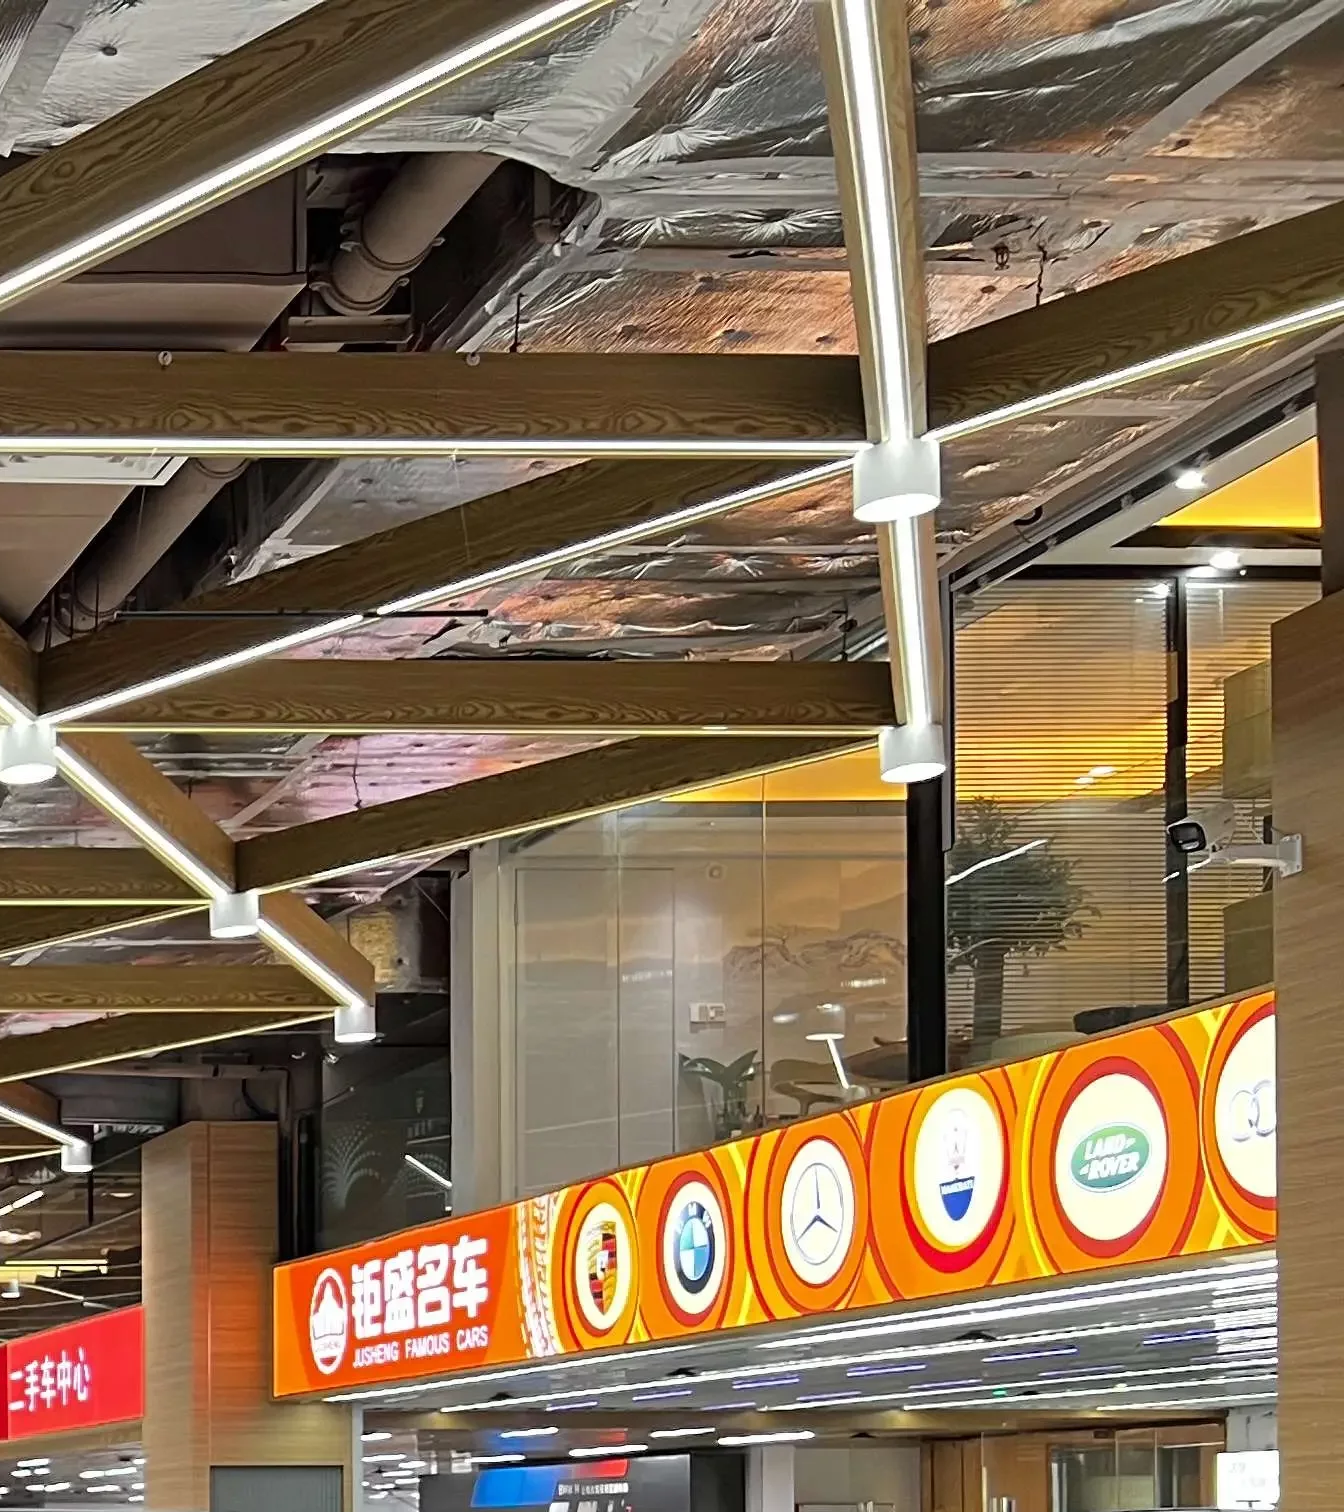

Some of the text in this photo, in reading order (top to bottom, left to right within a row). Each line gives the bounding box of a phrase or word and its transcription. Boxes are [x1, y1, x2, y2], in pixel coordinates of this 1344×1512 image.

[1084, 1133, 1126, 1160] LAND
[1087, 1151, 1139, 1180] ROVER
[351, 1234, 488, 1340] 钜盛名车
[353, 1325, 488, 1369] JUSHENG FAMOUS CARS
[8, 1346, 90, 1412] 二手车中心
